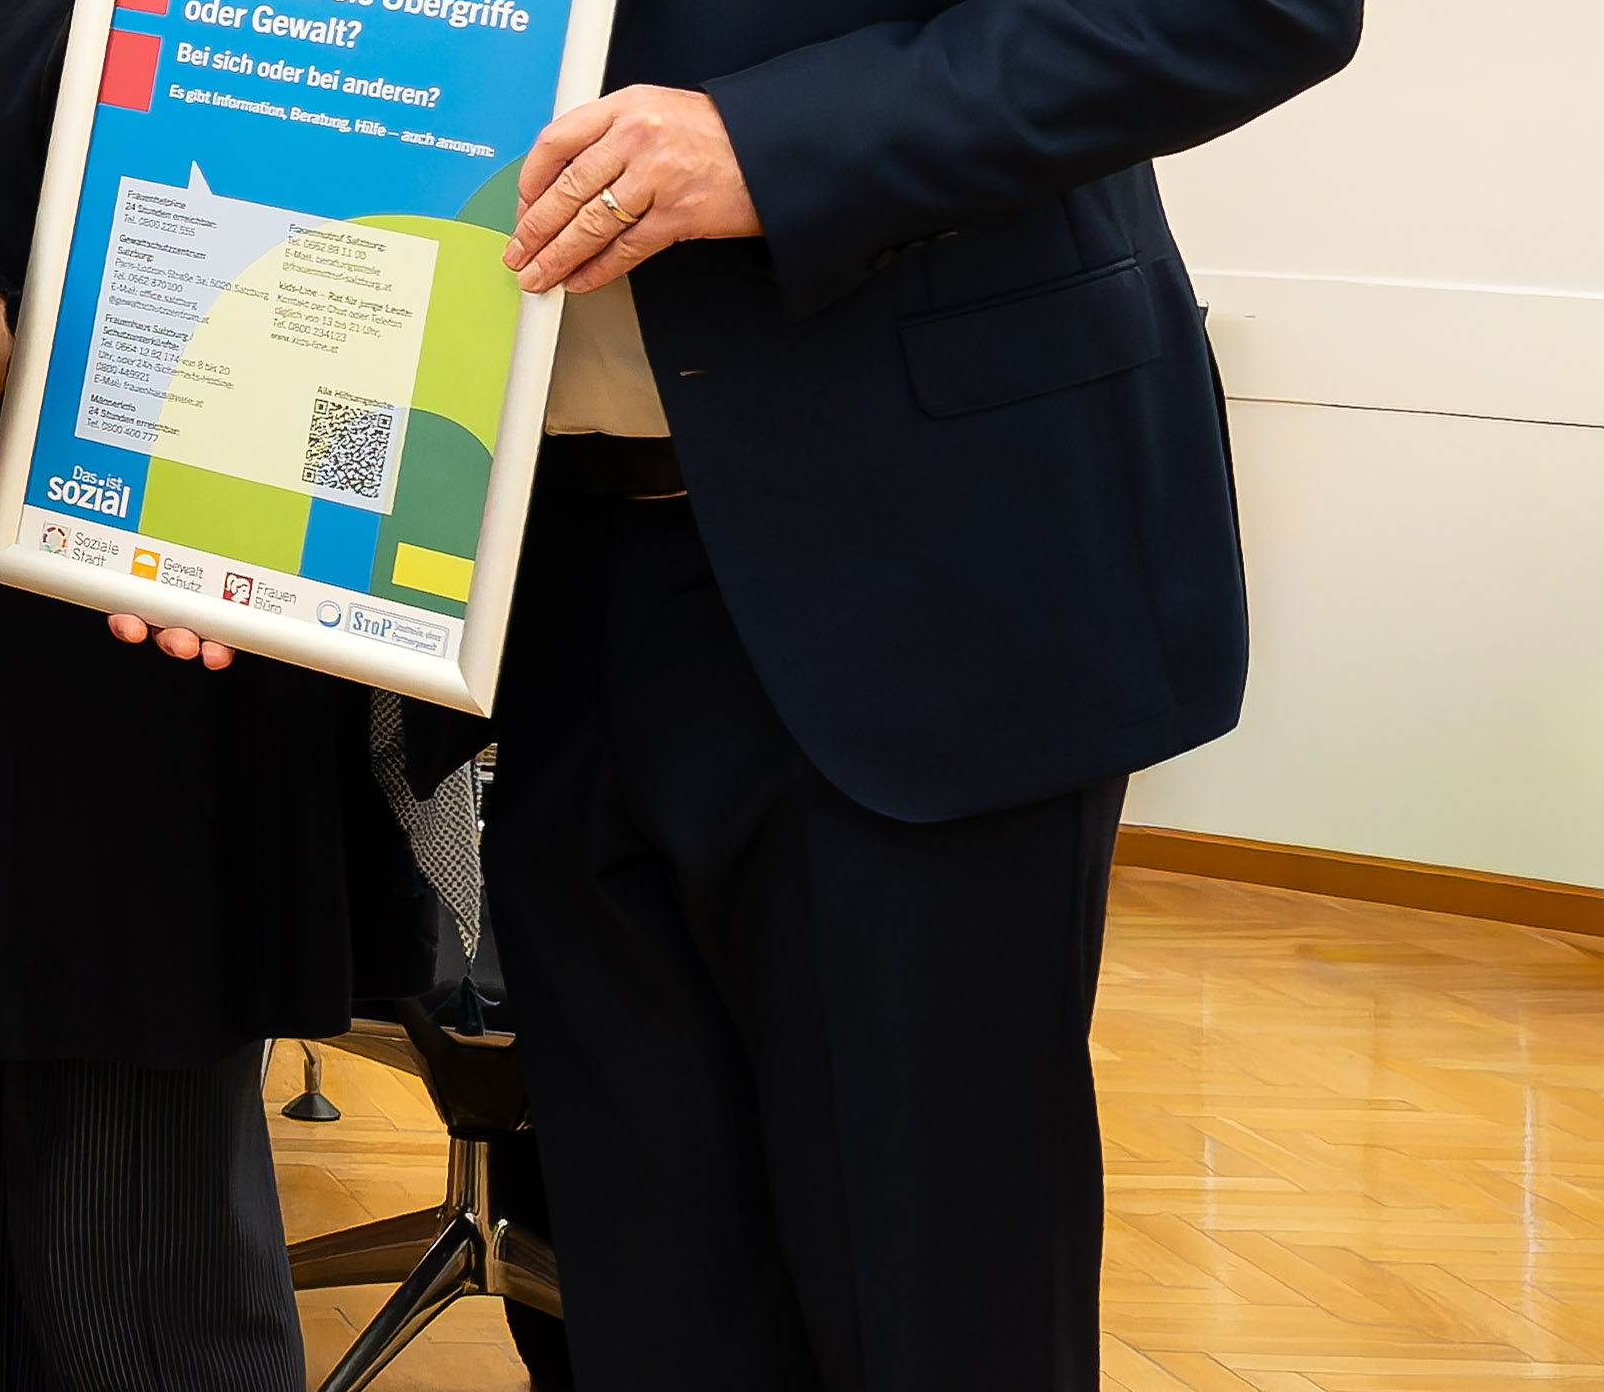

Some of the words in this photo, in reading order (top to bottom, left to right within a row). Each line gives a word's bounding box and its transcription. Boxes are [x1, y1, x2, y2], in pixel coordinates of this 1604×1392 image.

[252, 5, 362, 48] Gewalt?
[177, 43, 210, 66] Bei
[212, 50, 253, 74] sich
[257, 60, 305, 83] oder
[307, 66, 340, 90] bei
[342, 77, 440, 107] anderen?
[48, 472, 130, 518] sozial
